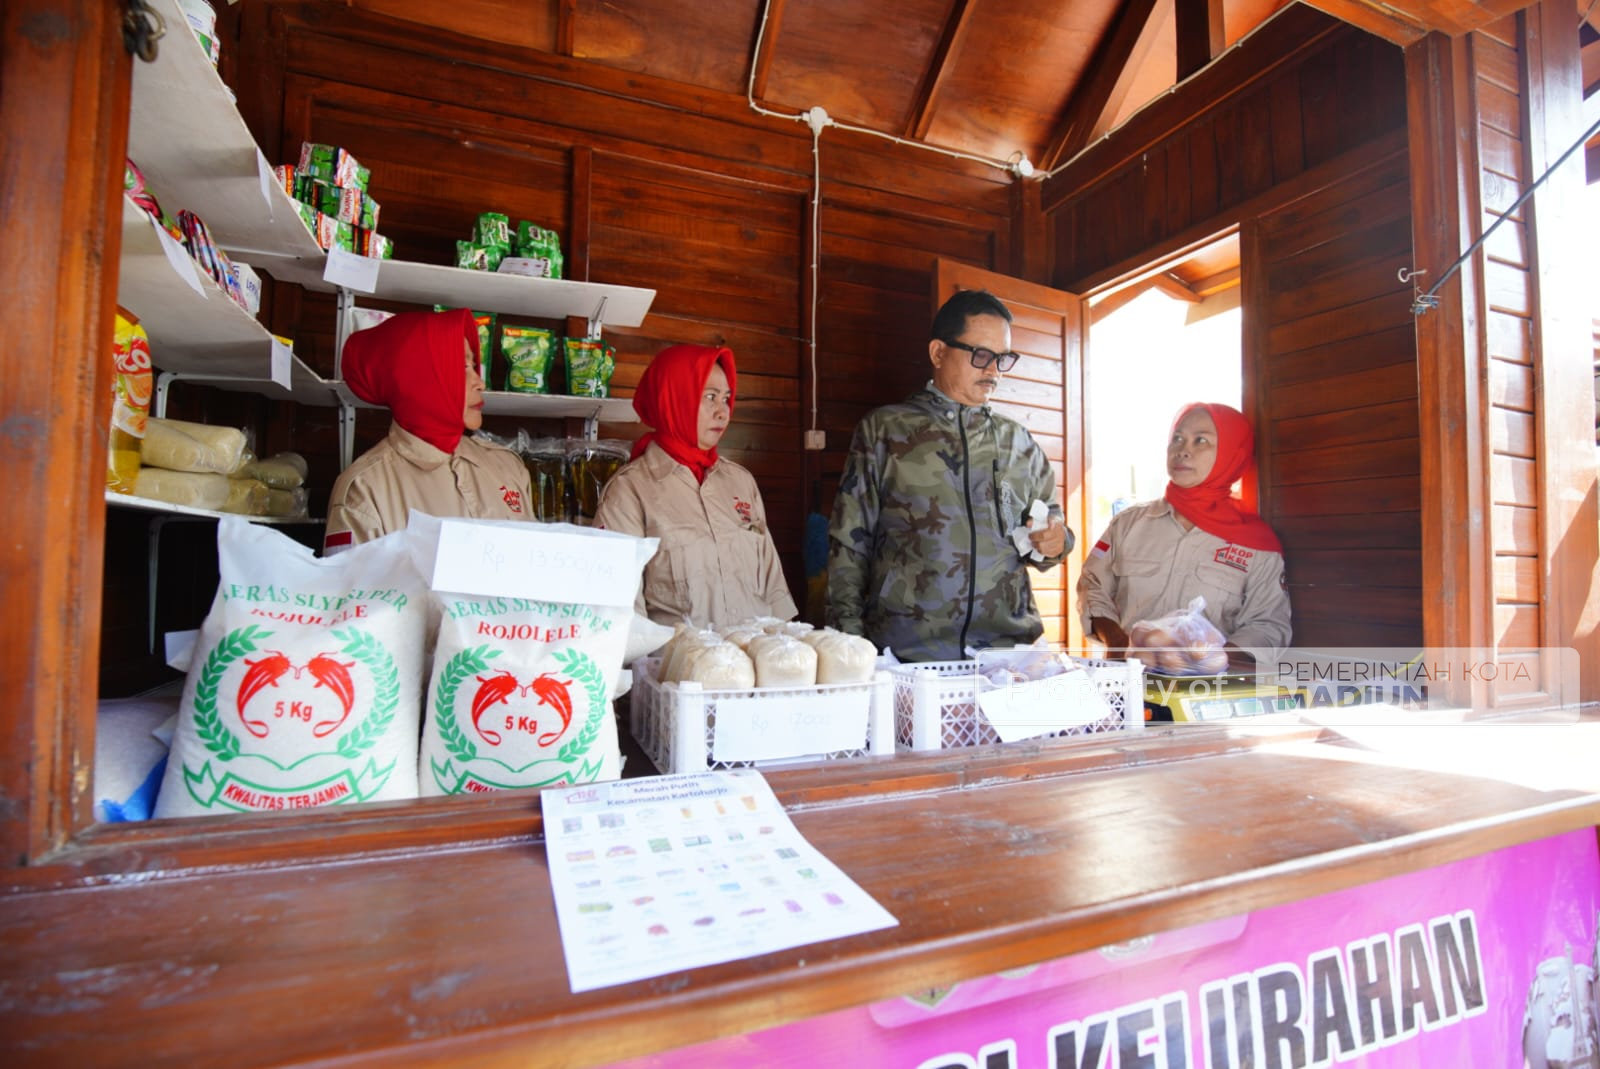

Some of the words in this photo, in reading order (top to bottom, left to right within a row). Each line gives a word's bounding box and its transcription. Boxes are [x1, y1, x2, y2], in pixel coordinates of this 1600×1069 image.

[1228, 554, 1249, 567] KEL
[1230, 547, 1253, 559] KOP
[222, 584, 290, 603] ERAS
[346, 588, 408, 612] SUPER
[448, 596, 508, 620] ERAS
[560, 602, 612, 632] SUPER
[477, 621, 581, 643] ROJOLELE
[274, 701, 284, 718] 5
[290, 702, 313, 722] Kg
[505, 715, 514, 730] 5
[518, 716, 538, 734] Kg
[223, 783, 284, 810] KWALITAS
[287, 782, 349, 809] TERJAMIN
